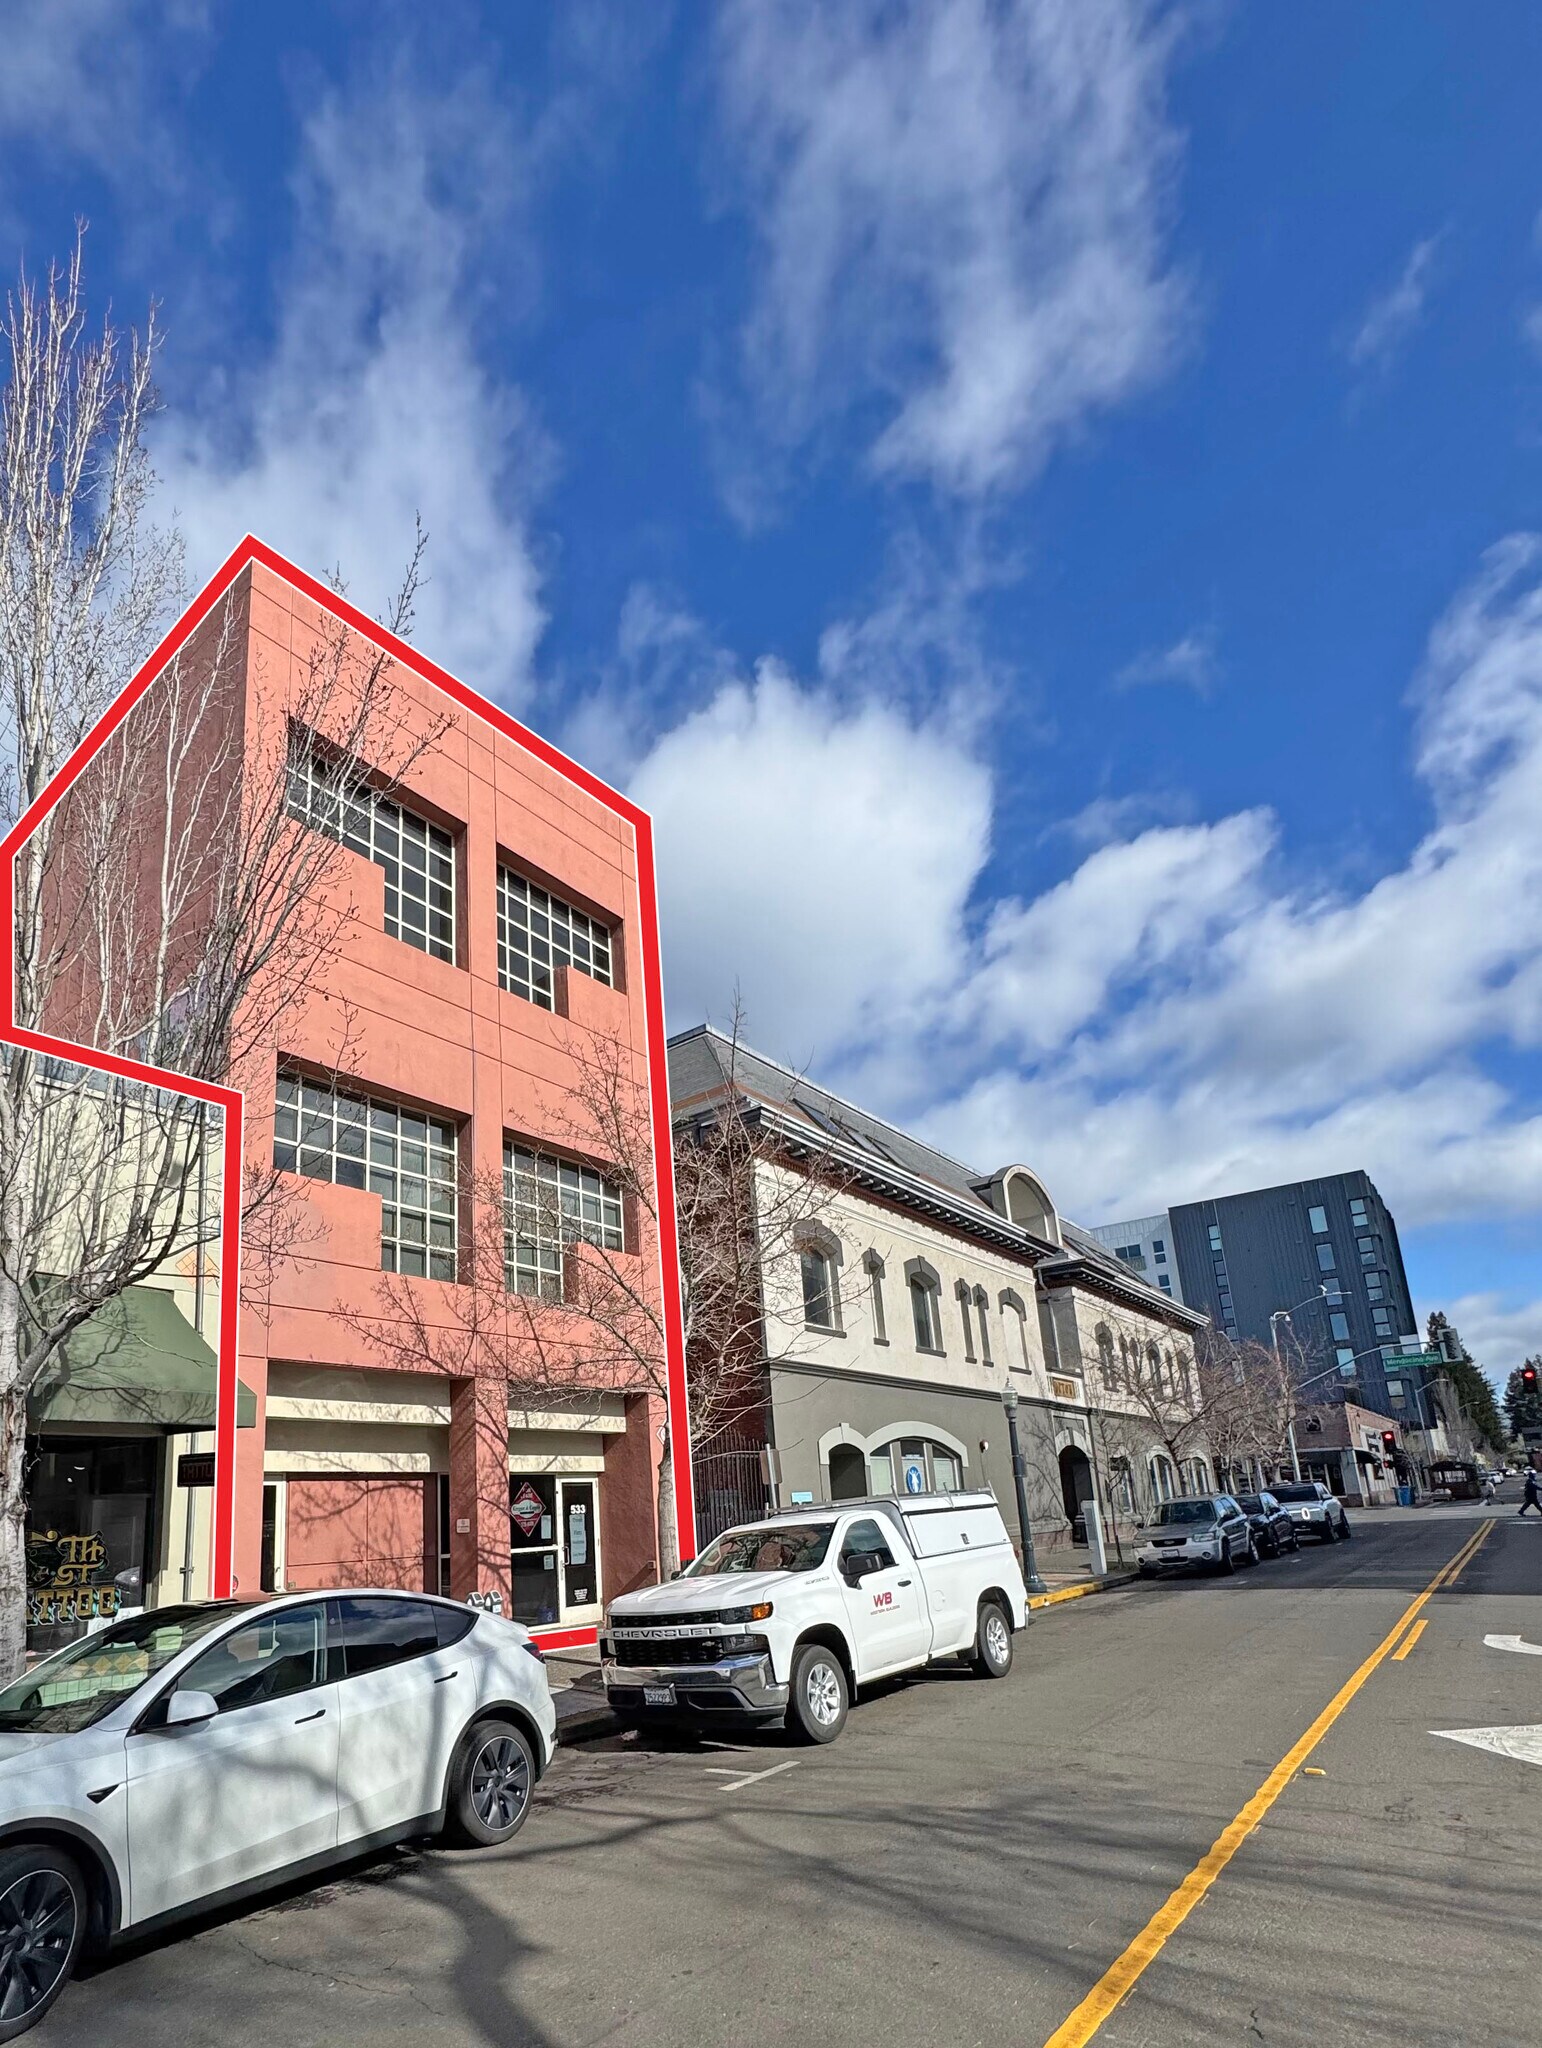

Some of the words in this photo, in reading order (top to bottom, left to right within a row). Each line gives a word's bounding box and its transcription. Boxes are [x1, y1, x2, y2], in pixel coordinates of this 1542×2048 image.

[1386, 1356, 1424, 1365] Mendocino
[570, 1504, 586, 1514] 533
[873, 1592, 893, 1607] WB
[613, 1627, 717, 1638] CHEVROLET
